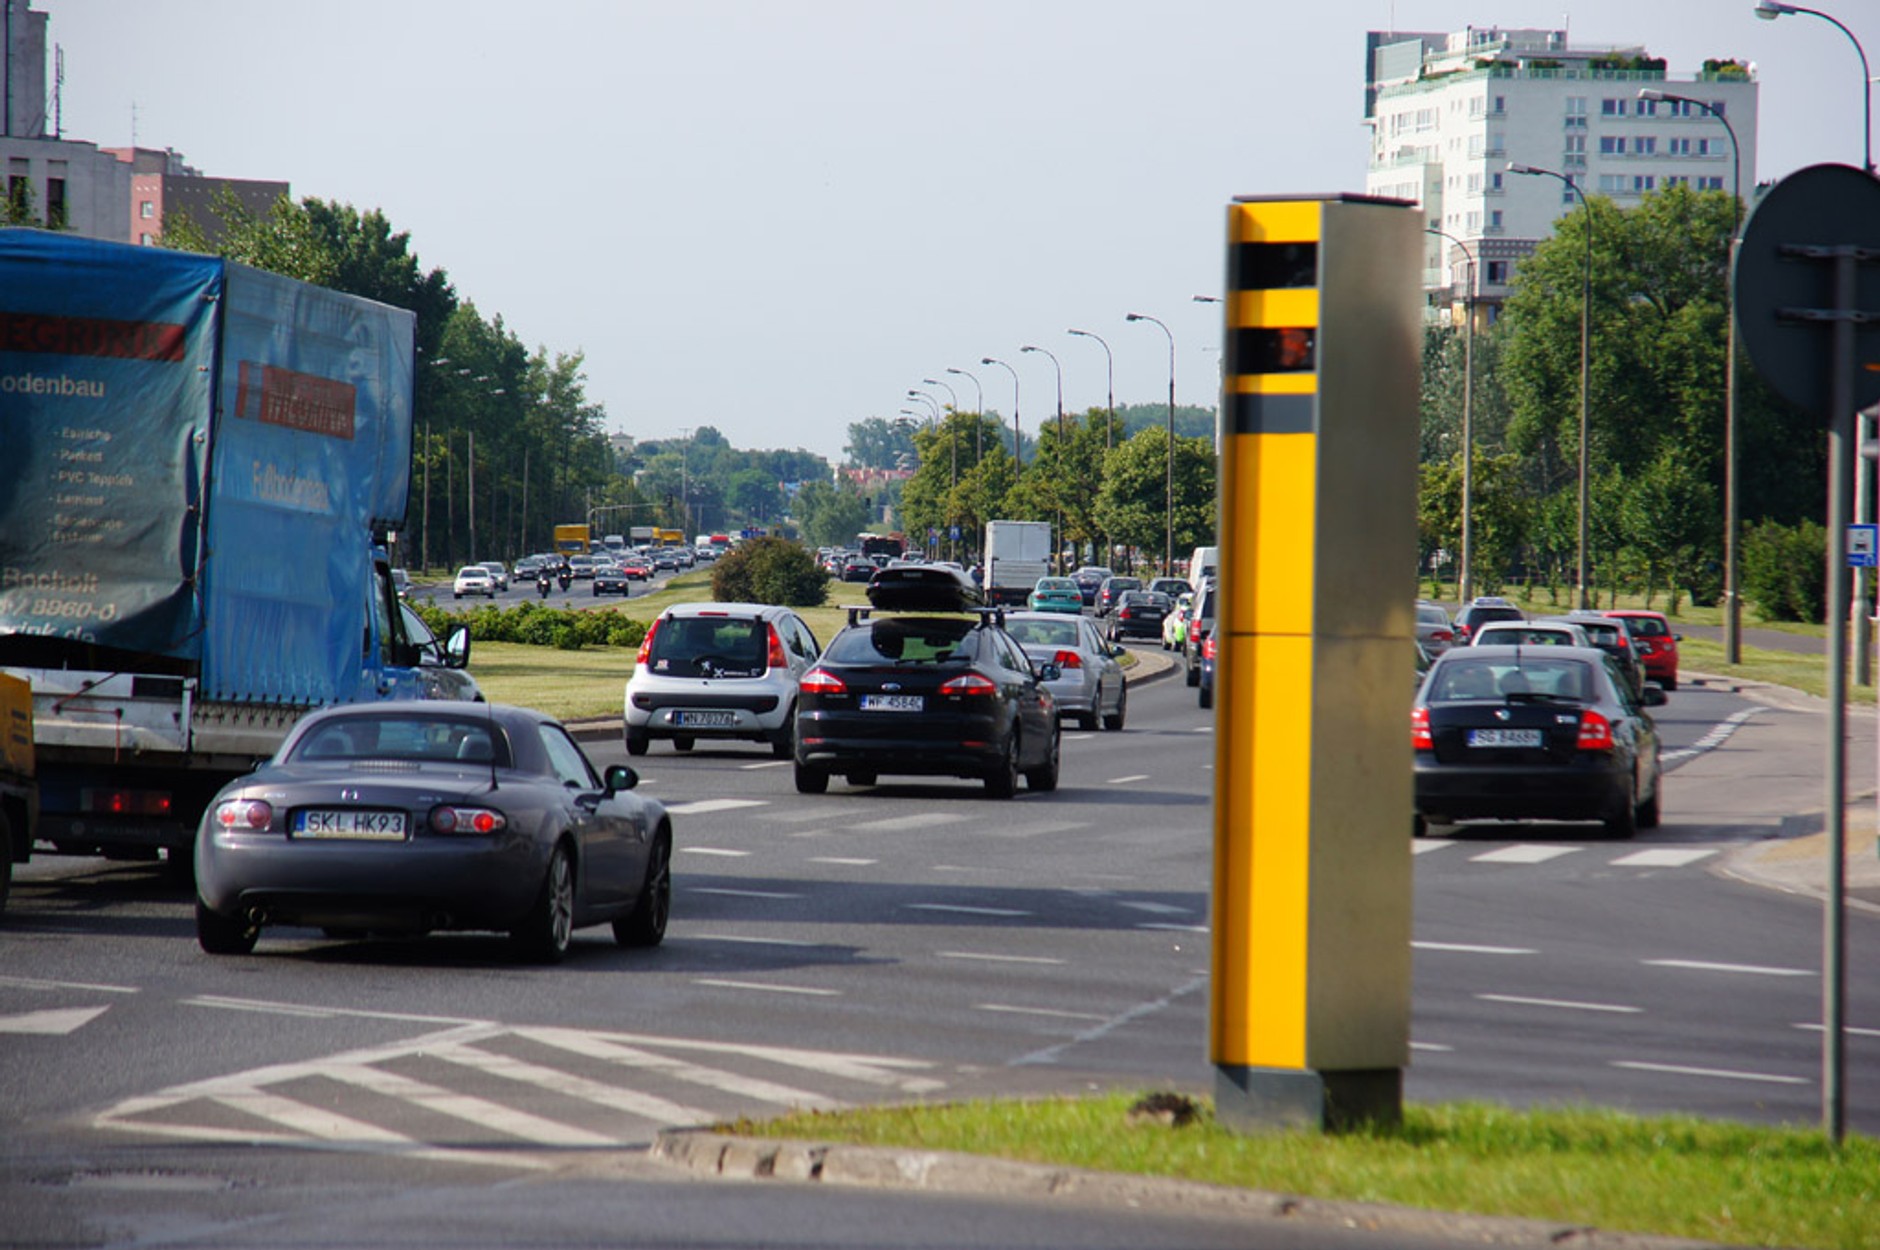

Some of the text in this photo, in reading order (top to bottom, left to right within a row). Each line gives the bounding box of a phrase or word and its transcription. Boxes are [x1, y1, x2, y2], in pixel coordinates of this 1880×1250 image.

[1, 373, 106, 397] odenbau
[3, 566, 99, 594] Bocholt
[32, 599, 116, 621] 8960-0
[307, 813, 401, 833] SKL HK93
